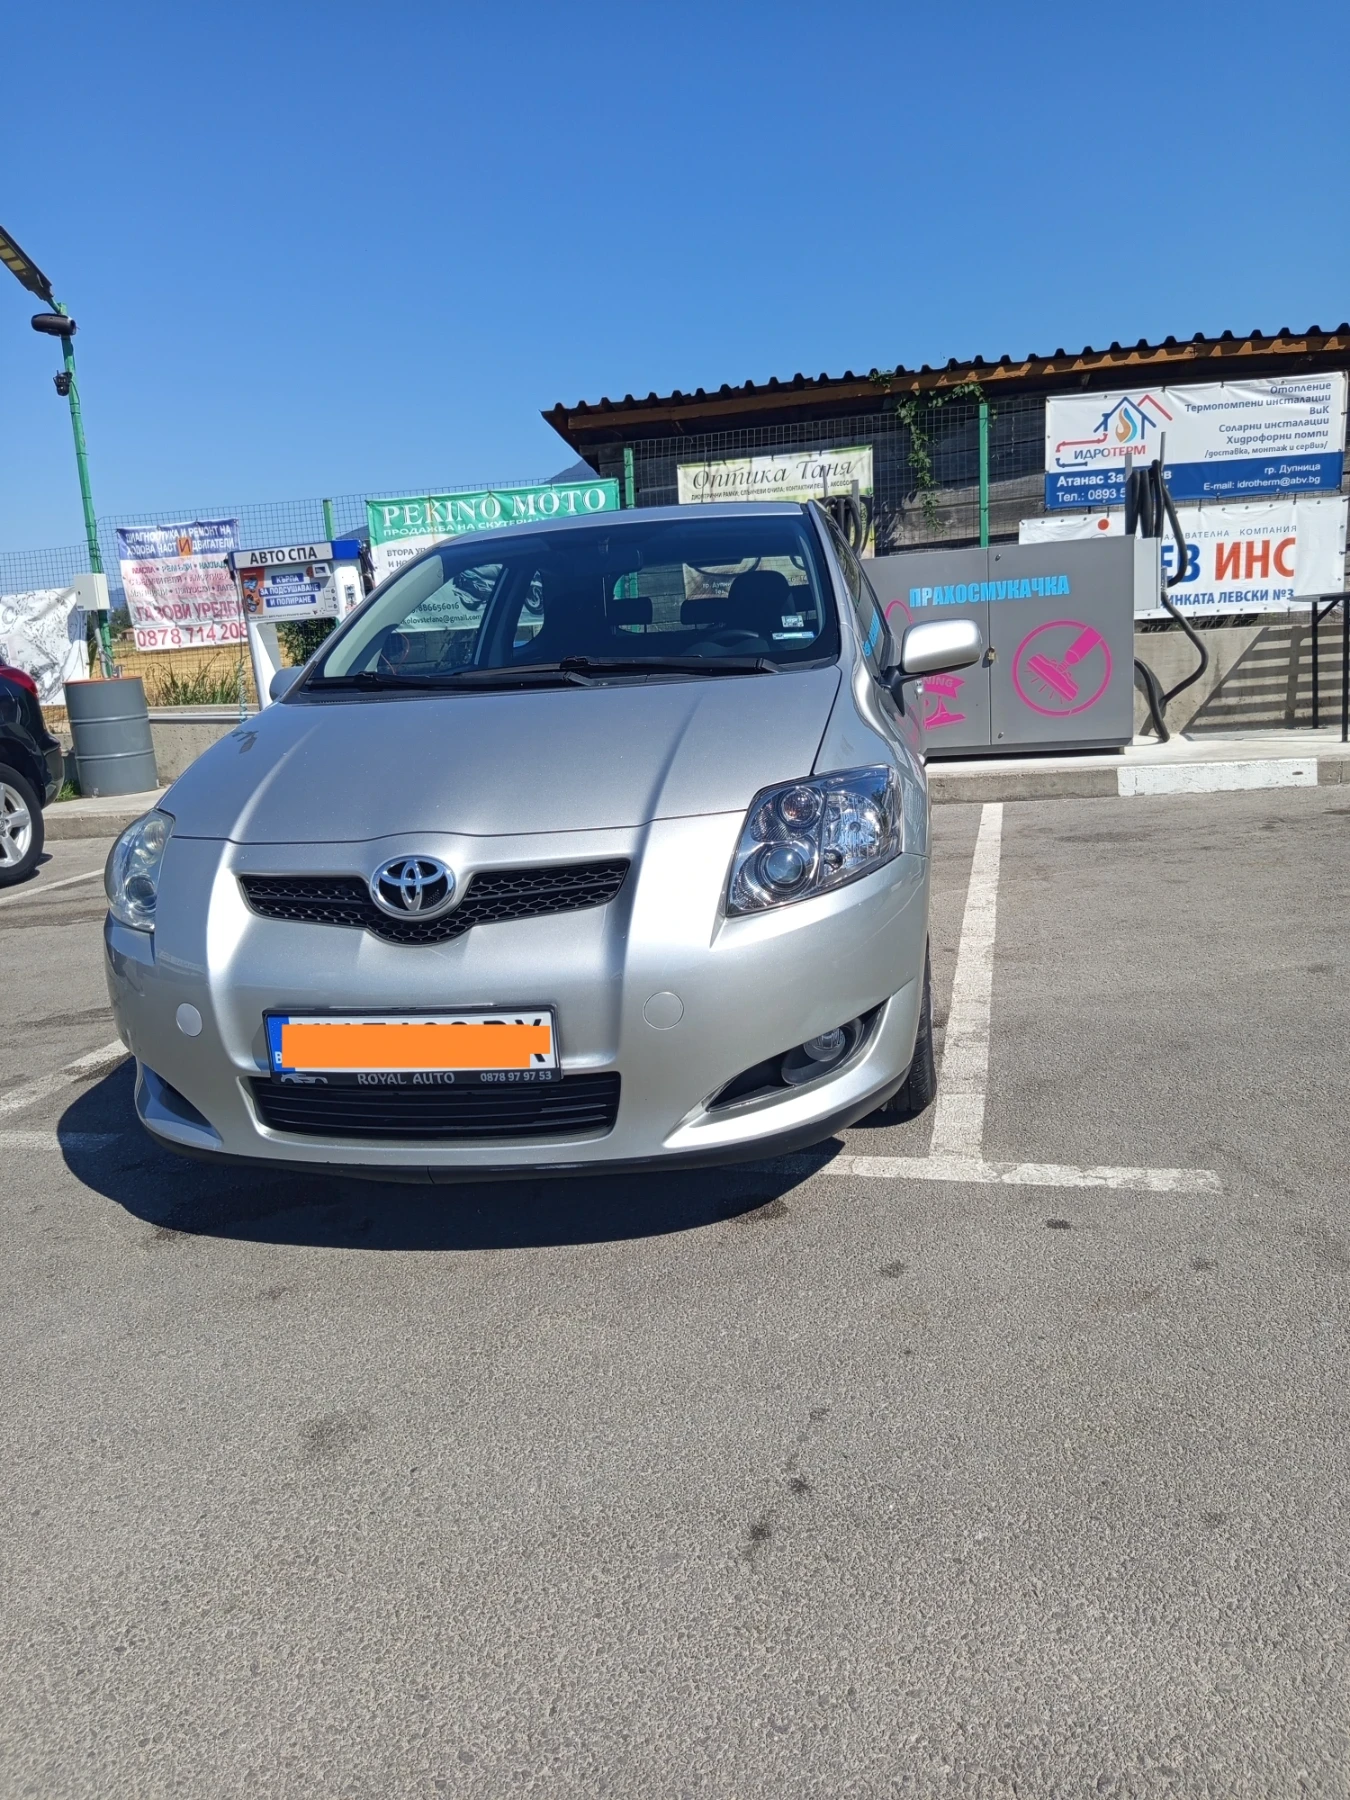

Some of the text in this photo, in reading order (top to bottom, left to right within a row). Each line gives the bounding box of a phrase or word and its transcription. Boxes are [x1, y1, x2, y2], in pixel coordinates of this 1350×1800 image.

[1270, 382, 1332, 394] Отопление
[1185, 394, 1331, 413] Термопомпени инсталации
[1309, 406, 1330, 416] ВиК
[1218, 418, 1330, 434] Соларни инсталации
[1226, 430, 1329, 446] Хидрофорни помпи
[1073, 445, 1146, 460] ИДРОТЕРМ
[1251, 445, 1287, 455] монтаж
[693, 456, 864, 490] Оптика Таня
[1264, 463, 1321, 475] гр. Дупница
[1056, 475, 1105, 488] Атанас
[1203, 475, 1321, 491] E-mail: idrotherm@abv.bg
[1056, 491, 1085, 503] Тел.:
[1087, 488, 1117, 500] 0893
[382, 488, 606, 527] PEKINO MOTO
[126, 530, 179, 543] ДИАГНОСТИКА
[188, 527, 218, 538] РЕМОНТ
[220, 525, 231, 535] НА
[383, 524, 455, 537] ПРОДАЖБА
[458, 523, 475, 531] НА
[1239, 525, 1297, 536] КОМПАНИЯ
[126, 545, 156, 556] ХОДОВА
[159, 542, 177, 554] ЧАСТ
[192, 538, 235, 552] ДВИГАТЕЛИ
[386, 548, 414, 557] ВТОРА
[249, 546, 318, 565] АВТО СПА
[1161, 537, 1297, 583] ЕВ ИНС
[275, 575, 300, 584] КЪРПА
[259, 583, 319, 596] ЗА ПОДСУШАВАНЕ
[909, 575, 1071, 608] ПРАХОСМУКАЧКА
[1218, 590, 1269, 604] ЛЕВСКИ
[276, 596, 312, 606] ПОЛИРАНЕ
[135, 603, 192, 621] ГАЗОВИ
[136, 621, 248, 647] 0878 714 208
[357, 1070, 552, 1085] ROYAL AUTO 0878 97 97 53
